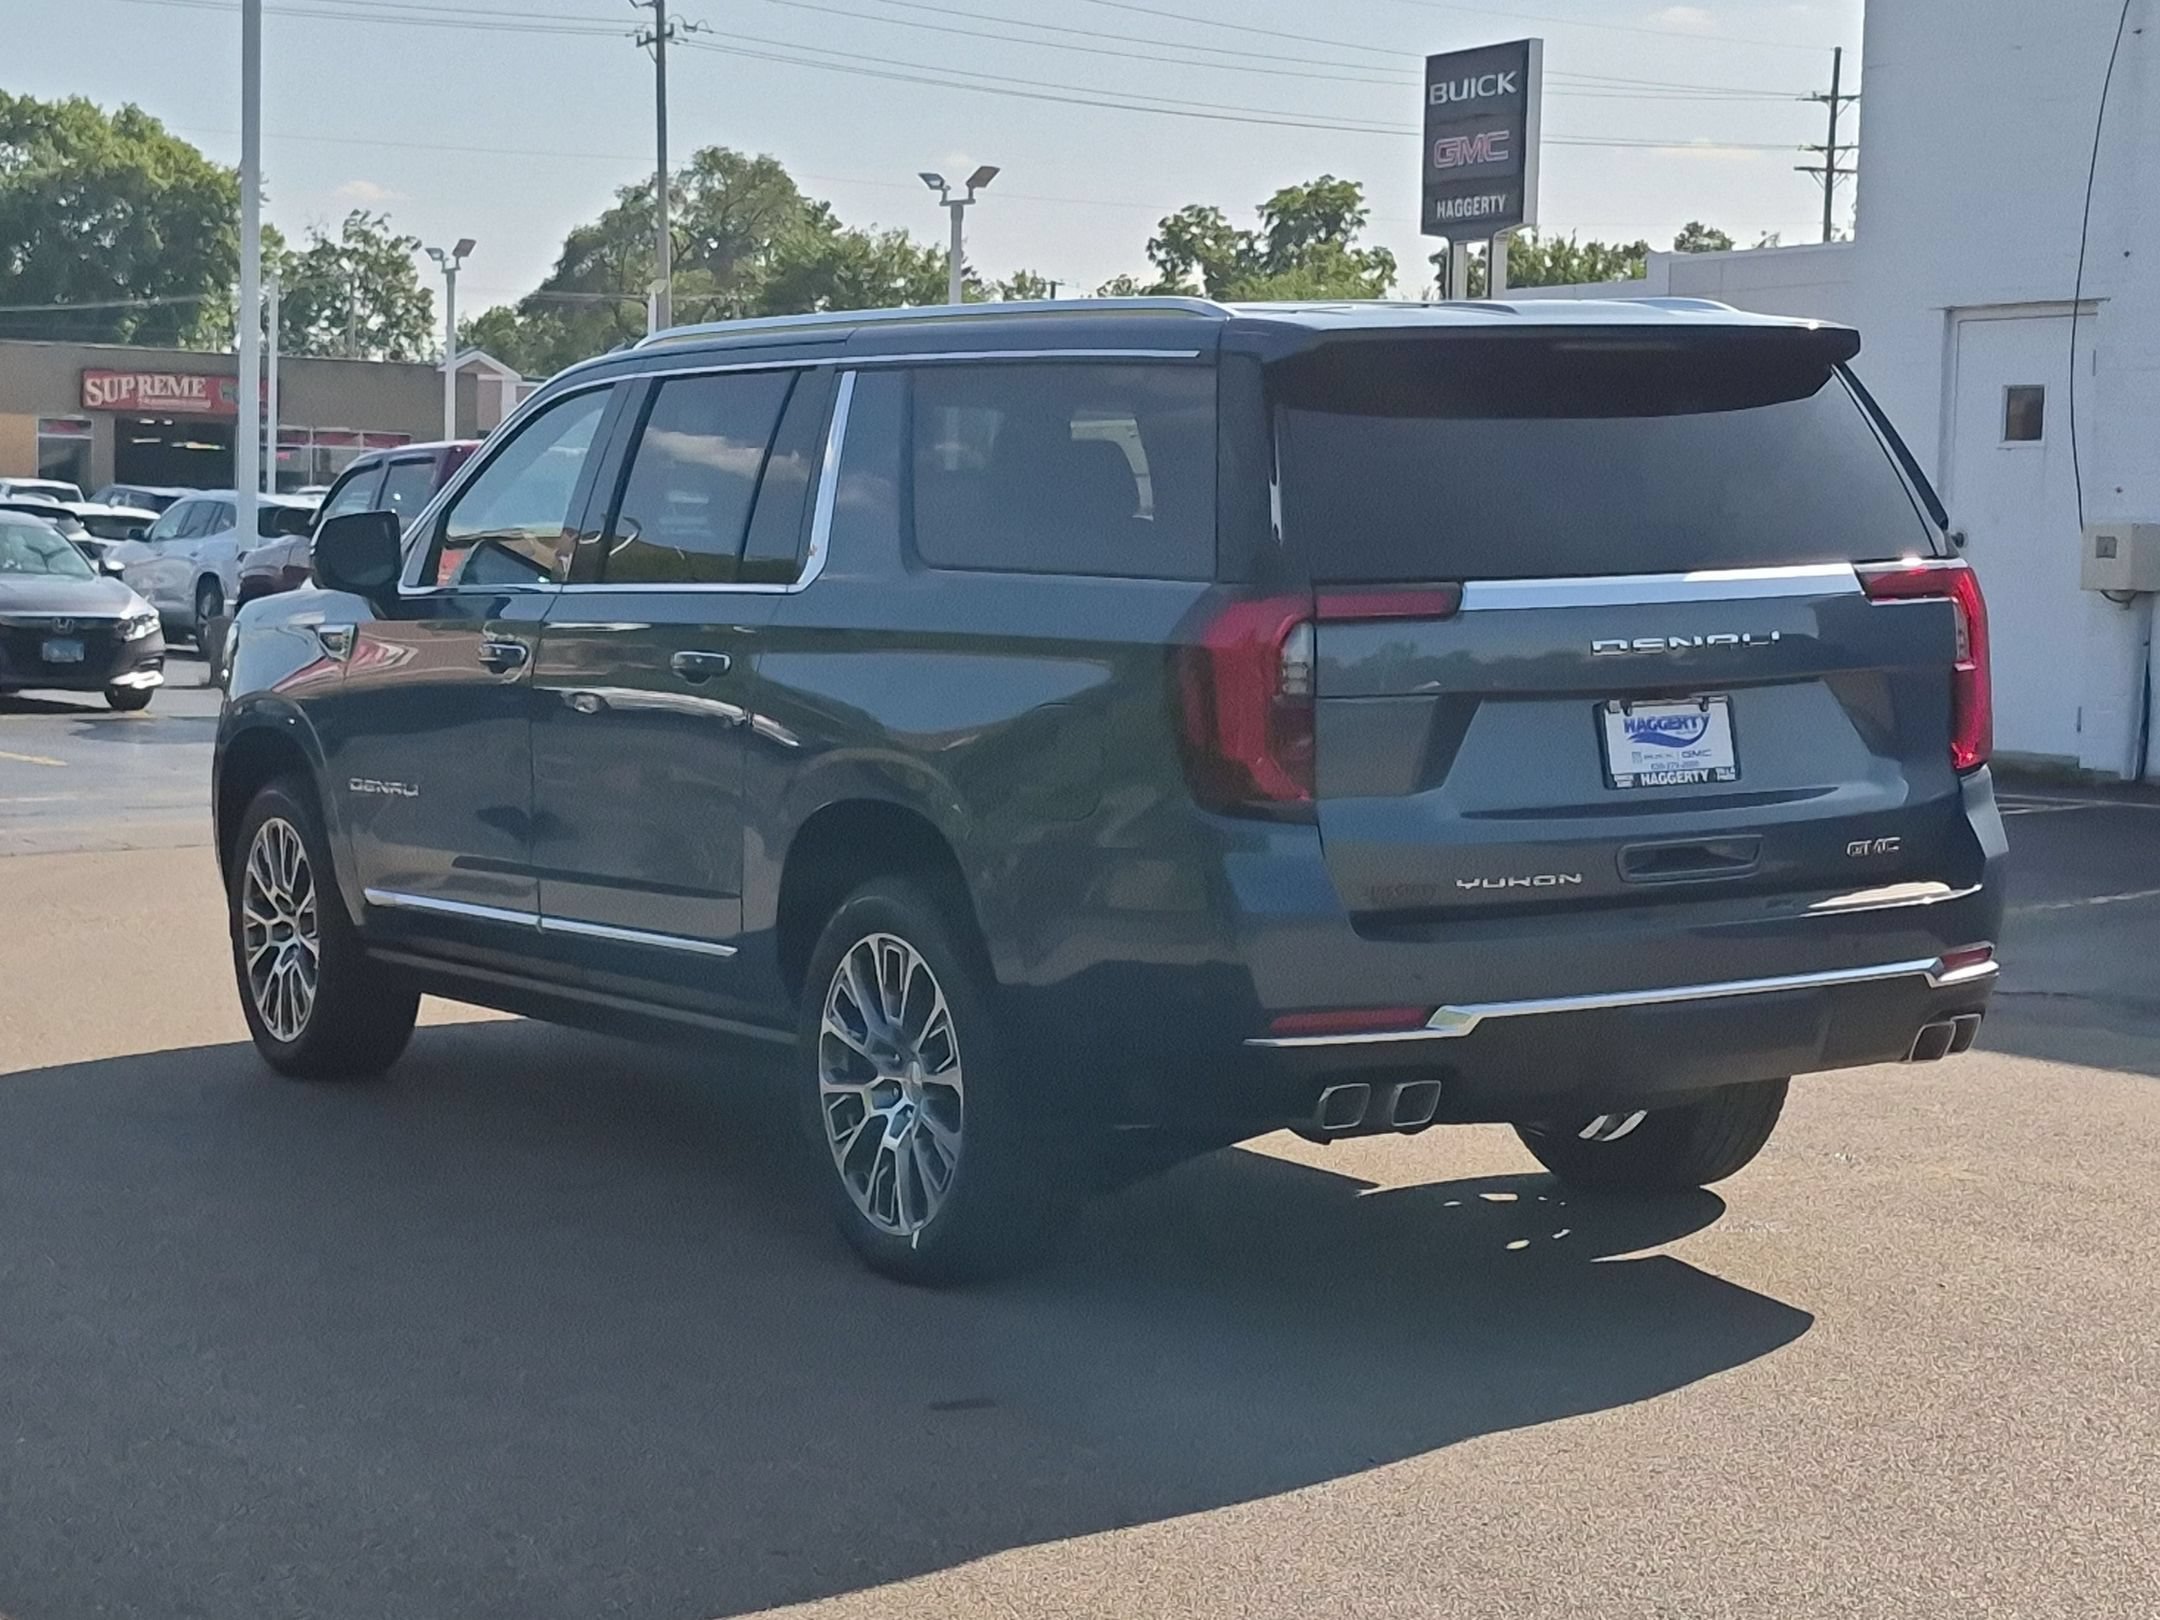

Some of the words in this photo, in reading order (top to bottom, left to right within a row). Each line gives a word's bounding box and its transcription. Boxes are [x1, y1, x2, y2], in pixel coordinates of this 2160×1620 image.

[1429, 70, 1518, 105] BUICK
[1434, 130, 1509, 168] GMC
[1436, 194, 1506, 219] HAGGERTY
[84, 375, 206, 407] SUPREME
[1592, 630, 1780, 656] DENALI
[1623, 713, 1711, 733] HAGGERTY
[349, 778, 419, 796] DENALI
[1640, 769, 1710, 786] HAGGERTY
[1847, 836, 1901, 857] GMC
[1456, 873, 1582, 890] YUKON
